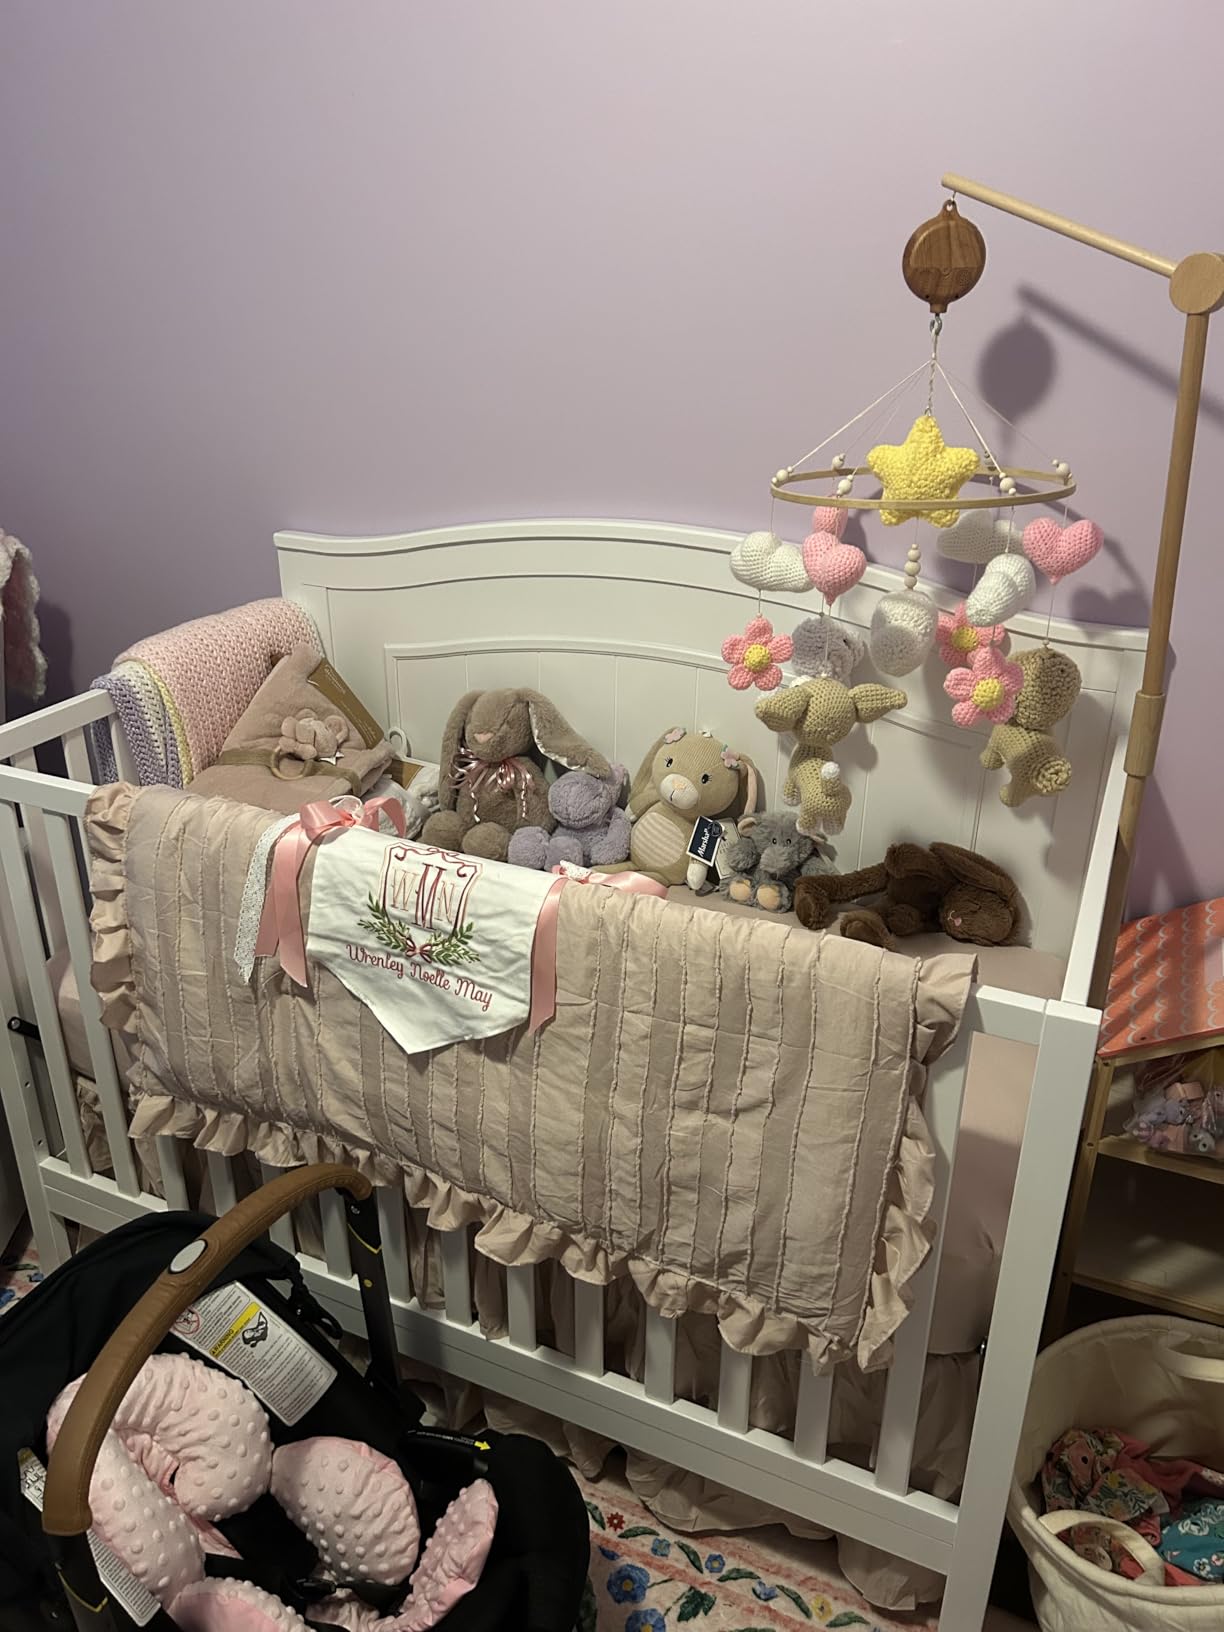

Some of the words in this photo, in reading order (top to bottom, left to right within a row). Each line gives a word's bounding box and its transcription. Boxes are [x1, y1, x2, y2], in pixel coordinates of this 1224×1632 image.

[346, 943, 404, 979] Wrenley
[410, 961, 451, 990] Noelle
[454, 977, 493, 1012] May
